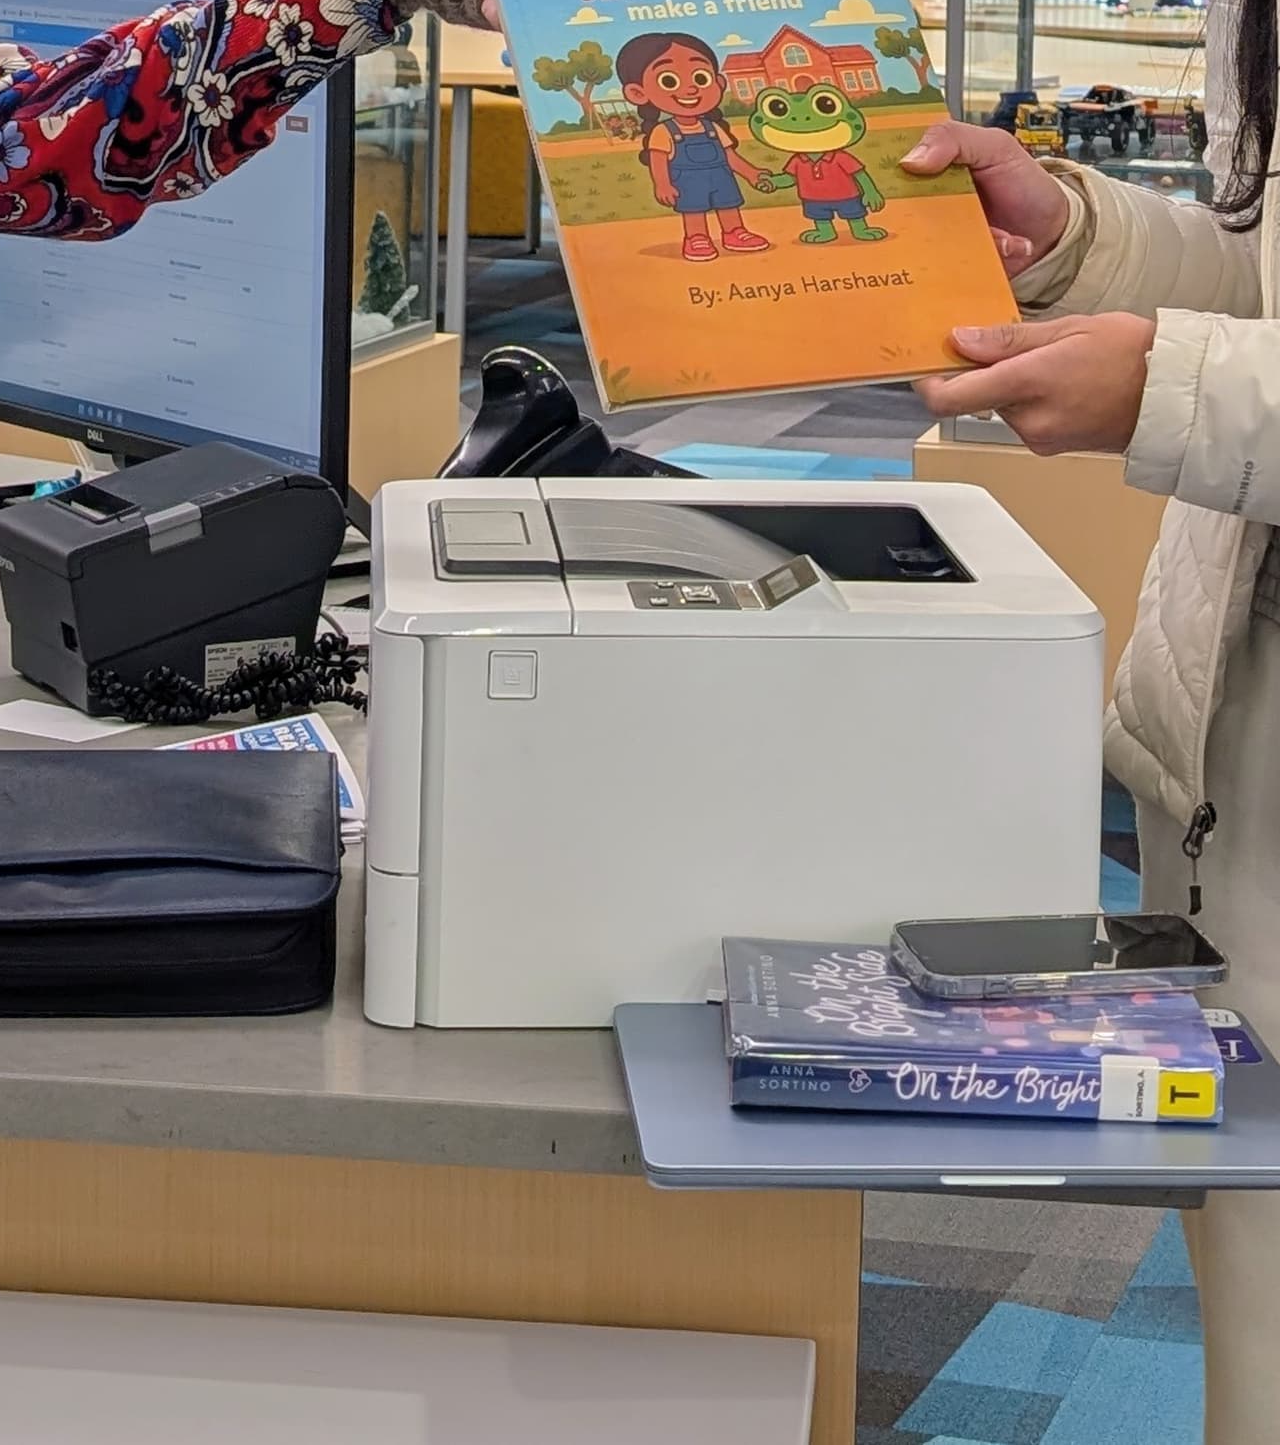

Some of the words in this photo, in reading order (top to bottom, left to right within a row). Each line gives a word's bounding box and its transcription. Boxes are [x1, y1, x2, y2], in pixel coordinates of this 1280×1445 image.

[627, 0, 699, 22] make
[704, 0, 719, 15] a
[688, 286, 723, 308] By:
[728, 281, 797, 302] Aanya
[801, 268, 914, 294] Harshavat
[87, 427, 105, 443] DELL
[788, 952, 849, 991] the
[803, 996, 862, 1023] On
[844, 985, 946, 1037] Bright
[770, 1064, 816, 1077] ANNA
[759, 1077, 832, 1093] SORTINO
[886, 1062, 941, 1101] On
[948, 1063, 1010, 1101] the
[1013, 1066, 1103, 1111] Bright
[1170, 1085, 1200, 1104] T
